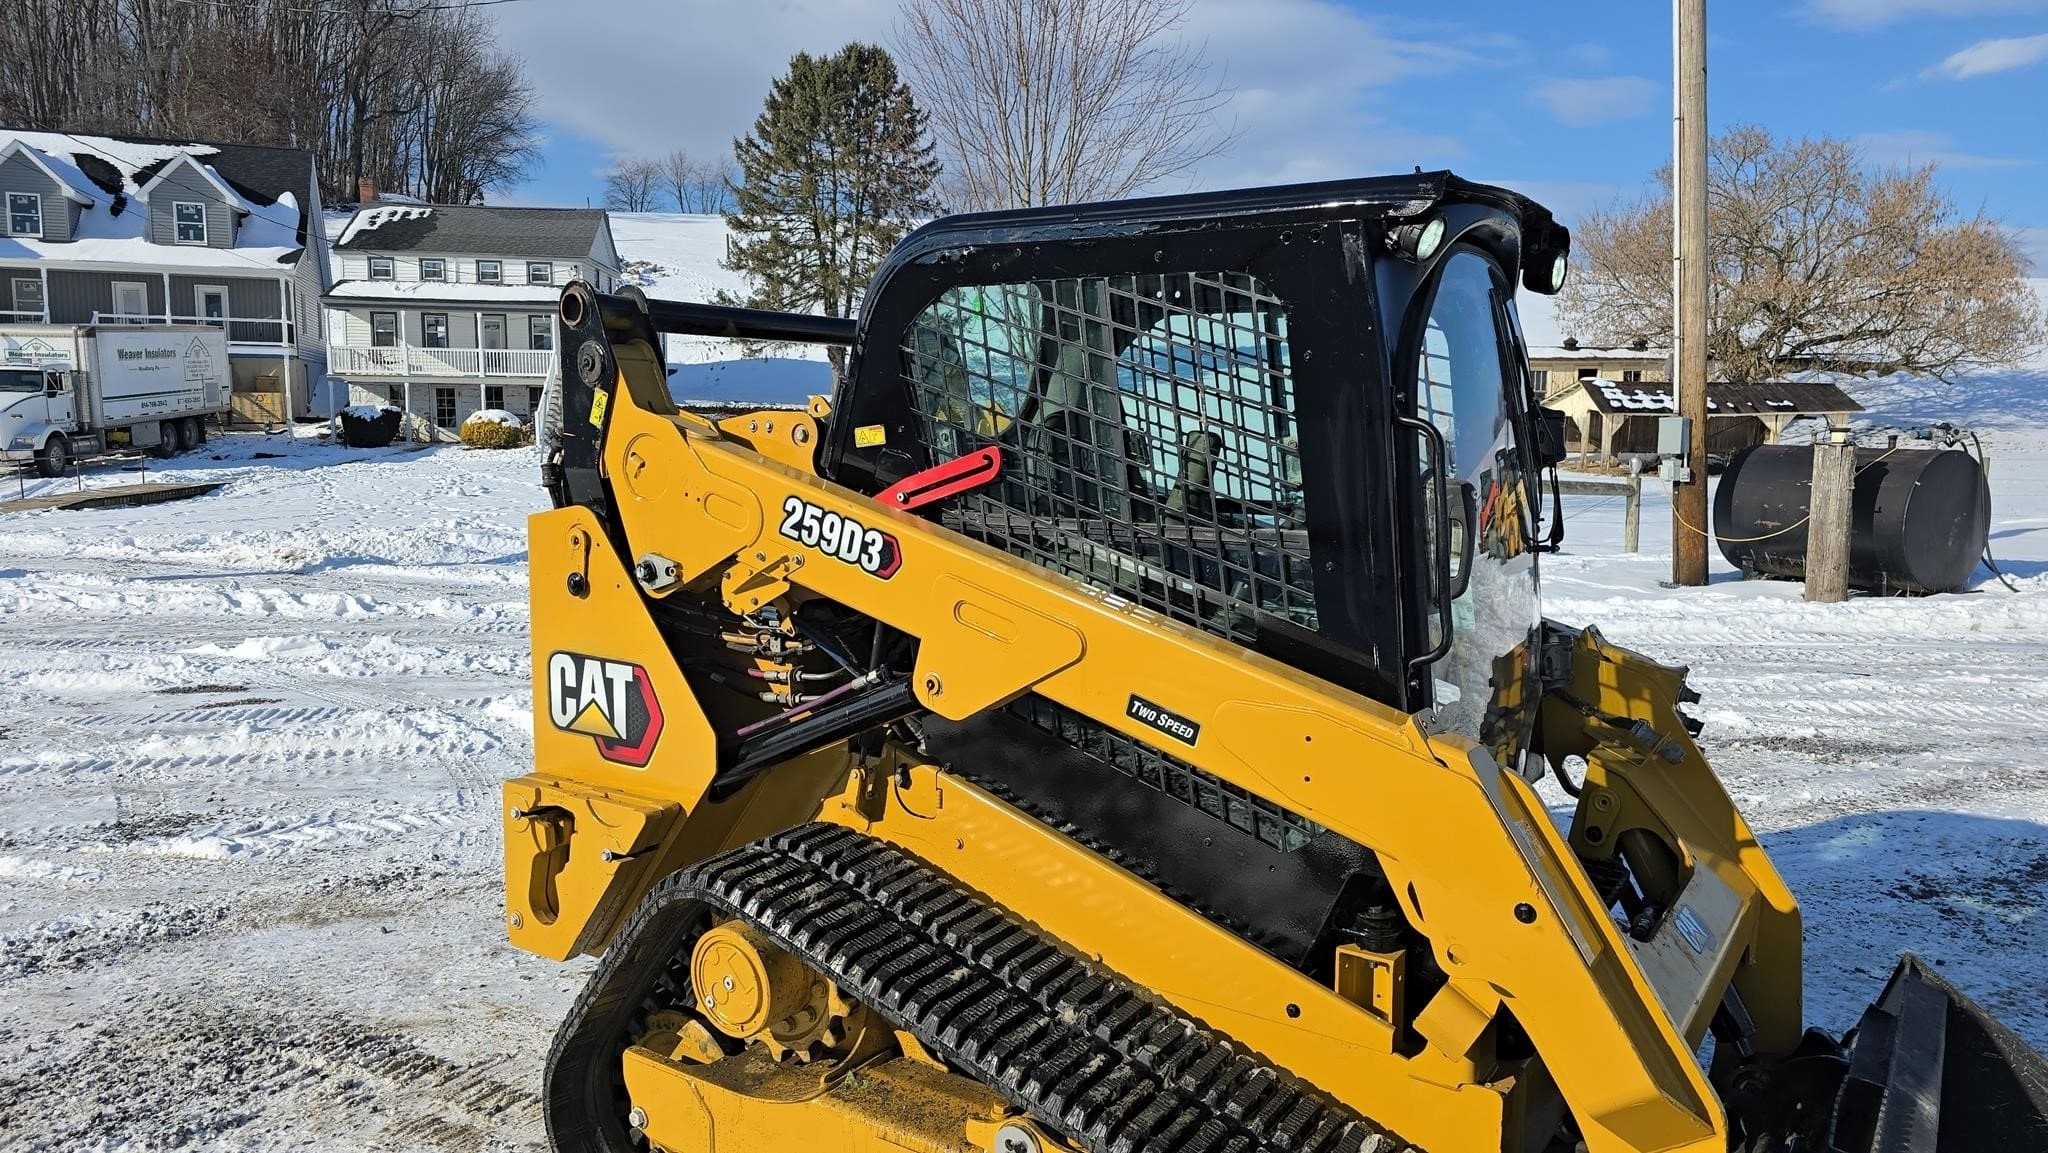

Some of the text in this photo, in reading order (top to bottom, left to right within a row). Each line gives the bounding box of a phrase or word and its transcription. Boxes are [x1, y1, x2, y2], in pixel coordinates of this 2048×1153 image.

[117, 348, 176, 360] Weaver Insulators
[780, 496, 884, 572] 259D3
[550, 653, 634, 740] CAT
[1131, 700, 1194, 739] TWO SPEED
